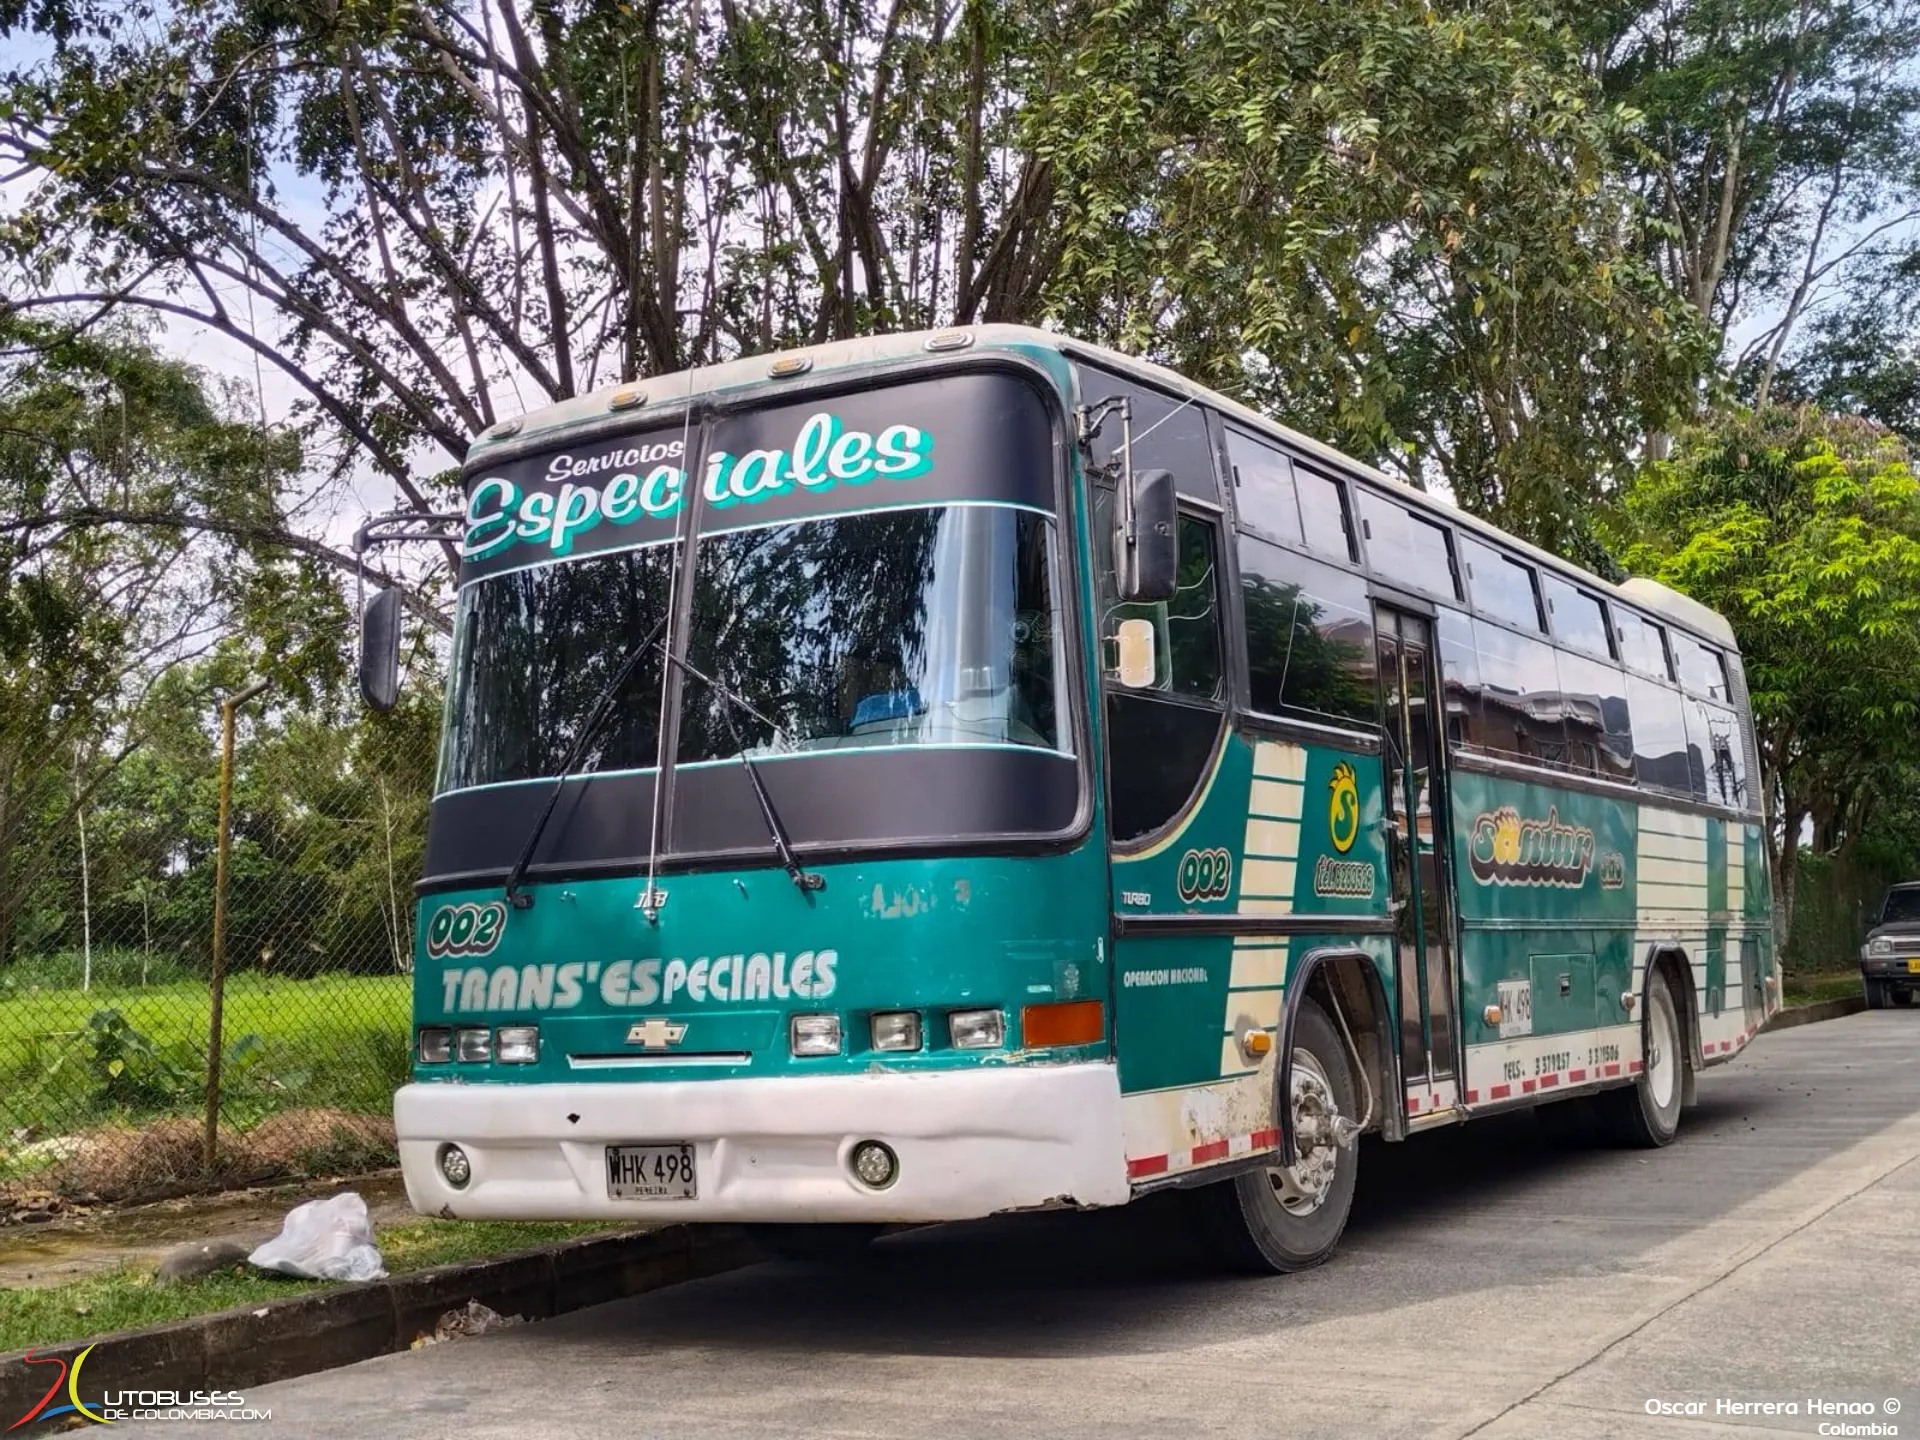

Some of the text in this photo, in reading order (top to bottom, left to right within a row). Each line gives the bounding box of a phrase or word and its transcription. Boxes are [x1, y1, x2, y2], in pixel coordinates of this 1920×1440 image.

[462, 412, 935, 558] Especiales
[545, 439, 684, 482] Servicios
[1122, 891, 1151, 906] TURBO
[1177, 847, 1232, 903] 002
[427, 901, 508, 960] 002
[609, 1154, 693, 1184] WHK 498
